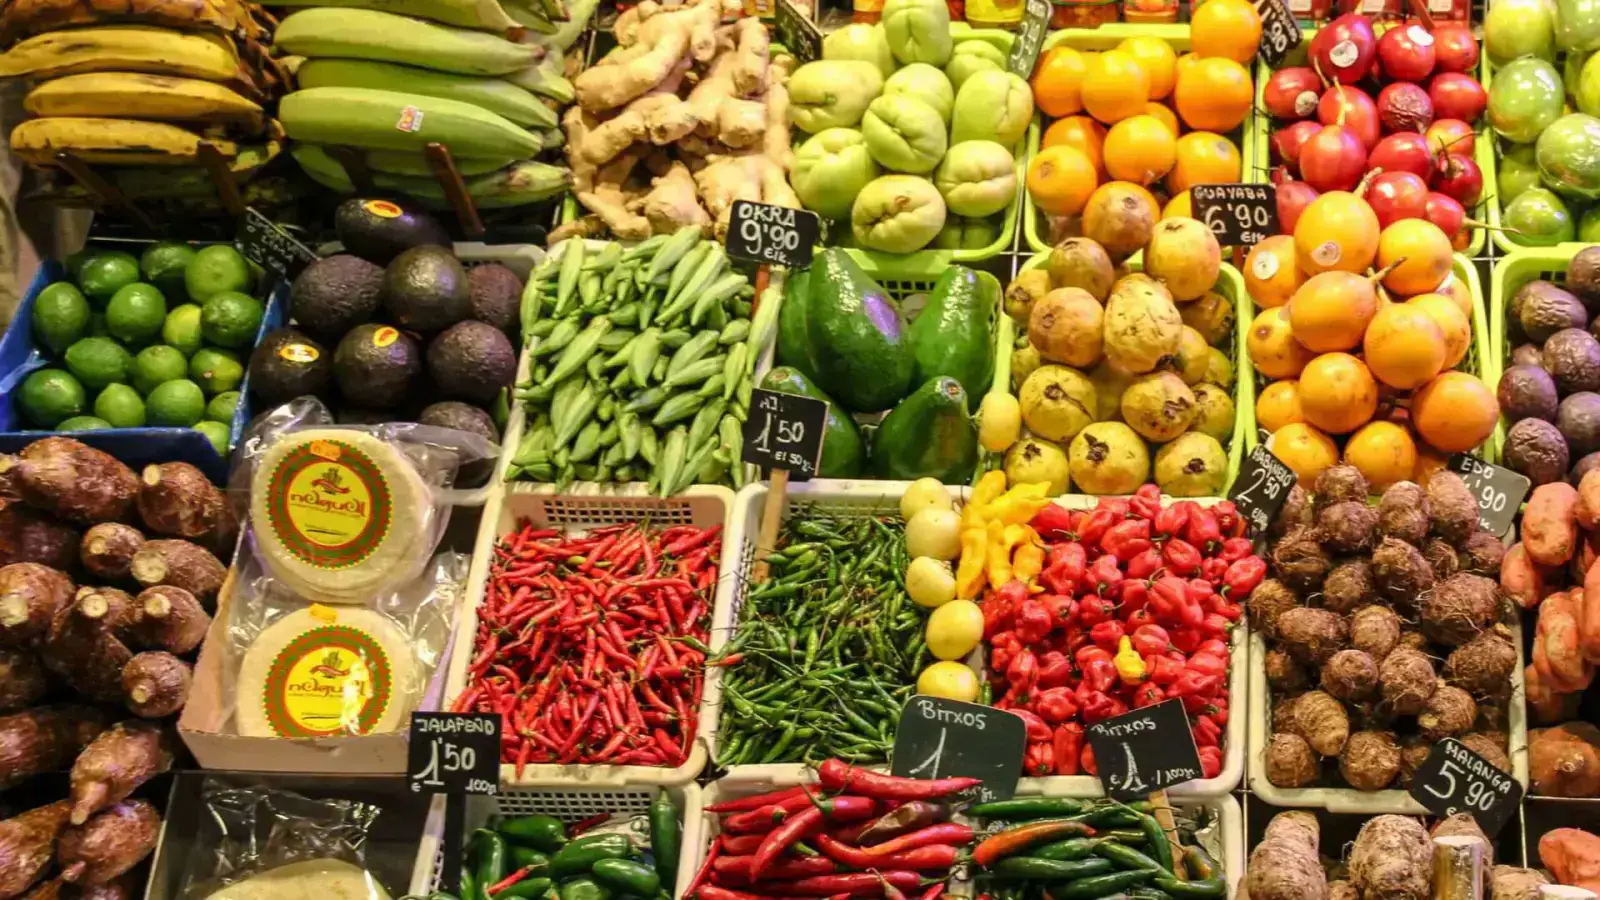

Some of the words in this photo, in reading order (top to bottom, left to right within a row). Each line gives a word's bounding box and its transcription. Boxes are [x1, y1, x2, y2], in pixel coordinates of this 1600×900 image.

[1194, 186, 1268, 200] GUAYABA
[738, 203, 796, 227] OKRA
[1205, 203, 1270, 234] 6'90
[741, 219, 800, 255] 9'90
[752, 411, 805, 453] 1'50
[1236, 468, 1280, 503] 2'50
[1461, 457, 1495, 479] EDO
[414, 717, 495, 735] JALAPEÑO
[412, 737, 476, 785] 1'50
[1445, 741, 1513, 794] MALANGA
[1423, 760, 1496, 811] 5'90
